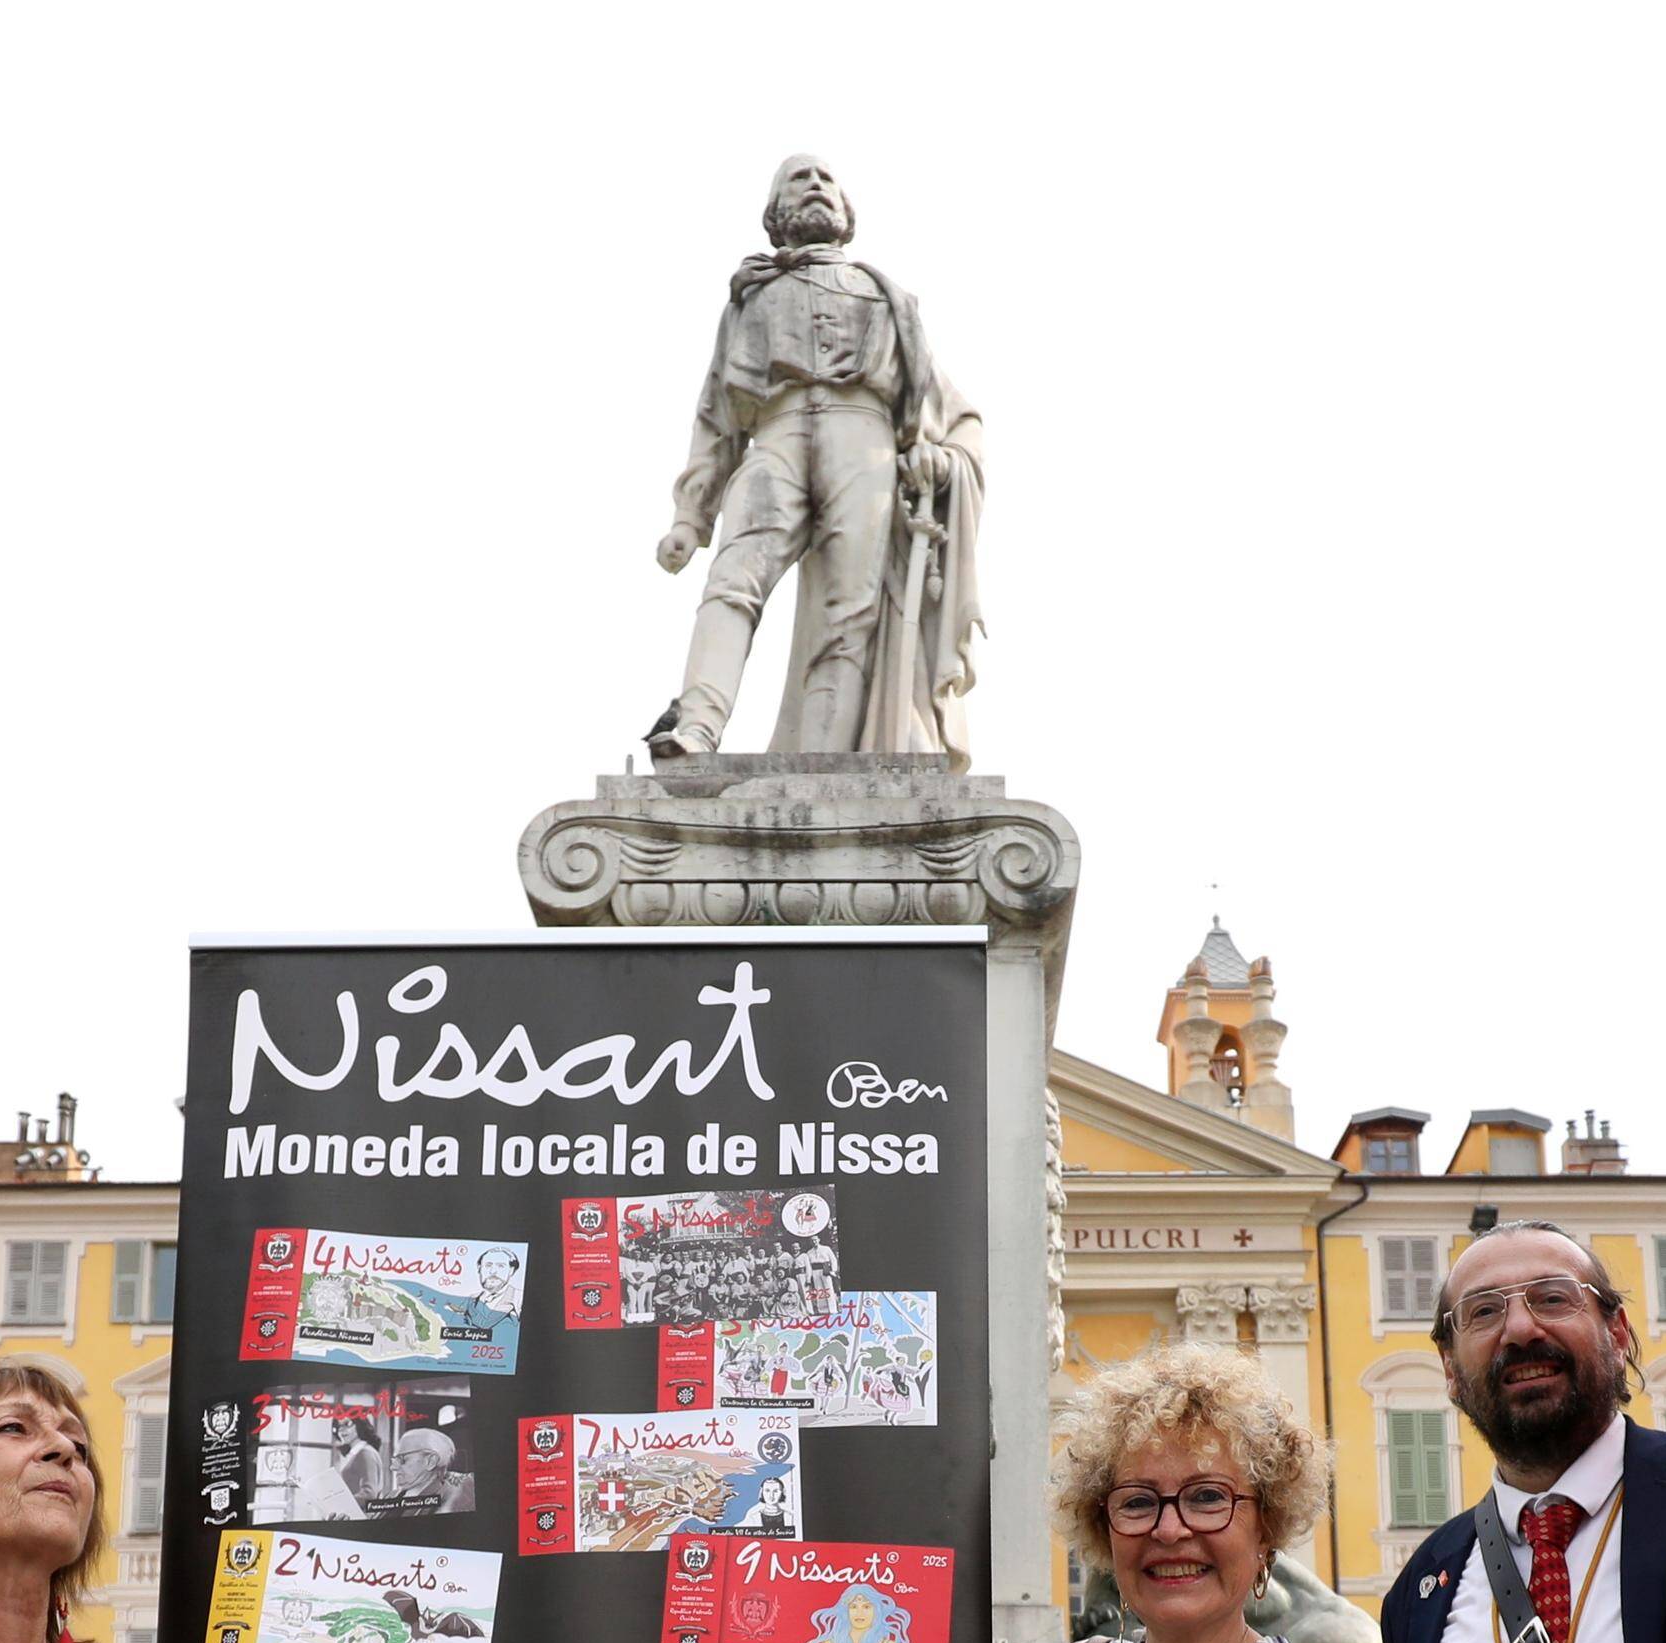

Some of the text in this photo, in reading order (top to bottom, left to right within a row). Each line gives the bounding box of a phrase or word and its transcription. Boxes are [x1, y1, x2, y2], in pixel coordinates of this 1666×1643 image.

[228, 961, 776, 1114] Nissart
[224, 1123, 939, 1179] Moneda locala de Nissa
[623, 1196, 774, 1241] 5 Nissarts
[313, 1235, 463, 1276] 4 Nissarts
[471, 1345, 505, 1360] 2025
[252, 1389, 406, 1435] 3 Nissarts
[759, 1416, 792, 1430] 2025
[578, 1417, 734, 1458] 7 Nissarts
[275, 1538, 437, 1590] 2 Nissarts
[736, 1541, 894, 1584] 9 Nissarts
[922, 1556, 948, 1568] 2025
